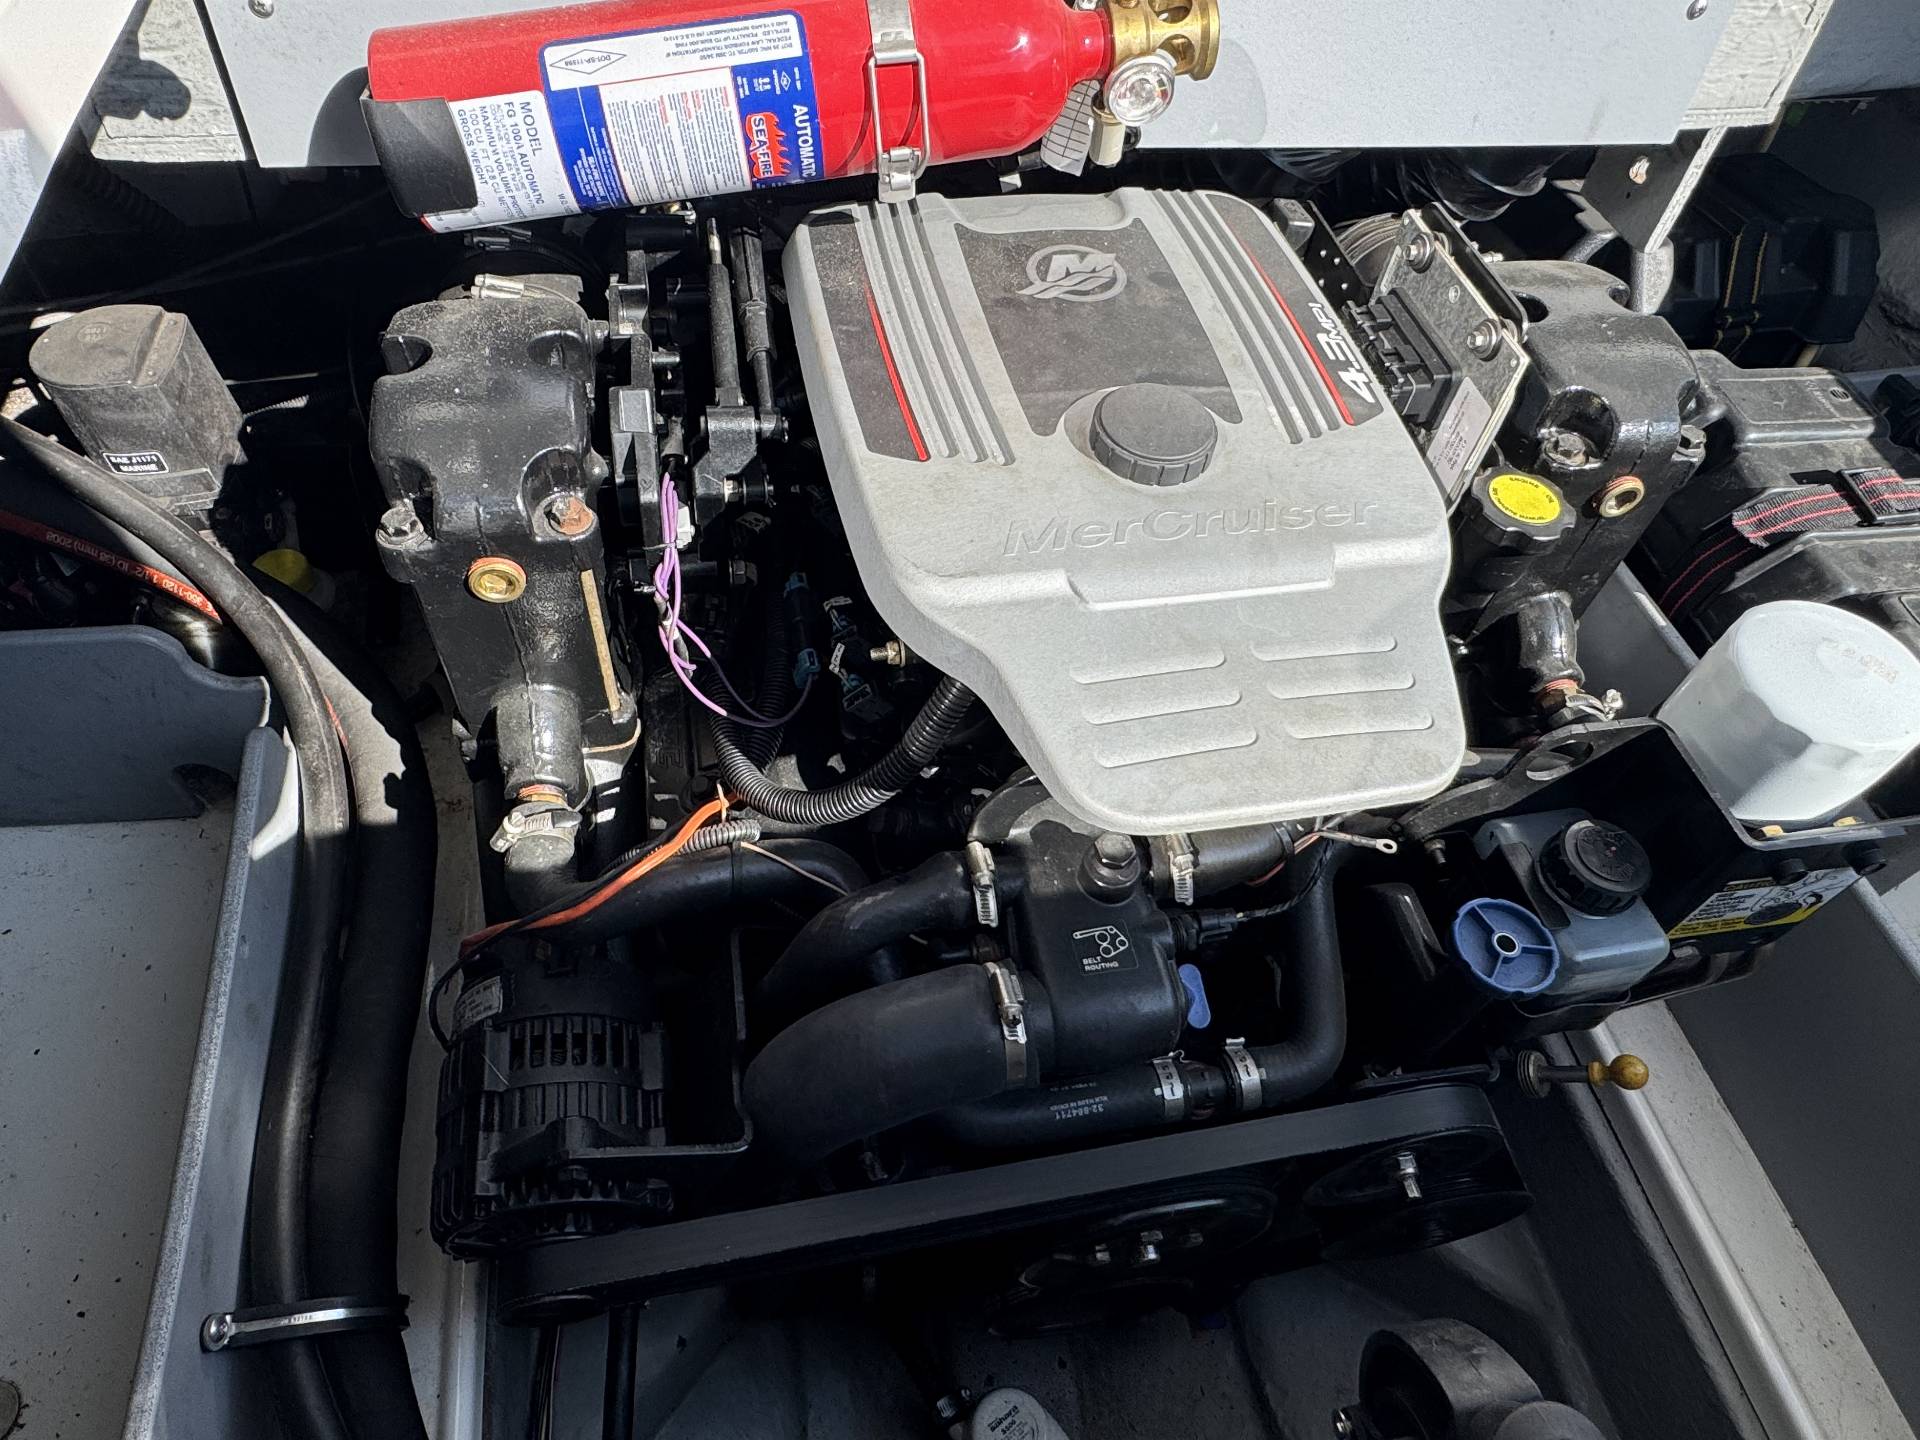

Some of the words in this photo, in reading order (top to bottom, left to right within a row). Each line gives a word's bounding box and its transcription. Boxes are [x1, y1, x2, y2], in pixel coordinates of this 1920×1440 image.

[457, 108, 474, 147] GROSS
[469, 149, 488, 186] WEIGHT
[473, 127, 484, 143] CU
[479, 147, 489, 161] FT
[478, 105, 499, 156] MAXIMUM
[493, 158, 512, 194] VOLUME
[504, 101, 516, 118] FG
[517, 152, 544, 204] AUTOMATIC
[519, 101, 543, 156] MODEL
[793, 104, 816, 177] AUTOMATIC
[1001, 499, 1378, 557] MerCruiser
[1082, 956, 1101, 964] BELT
[1084, 961, 1118, 971] ROUTING
